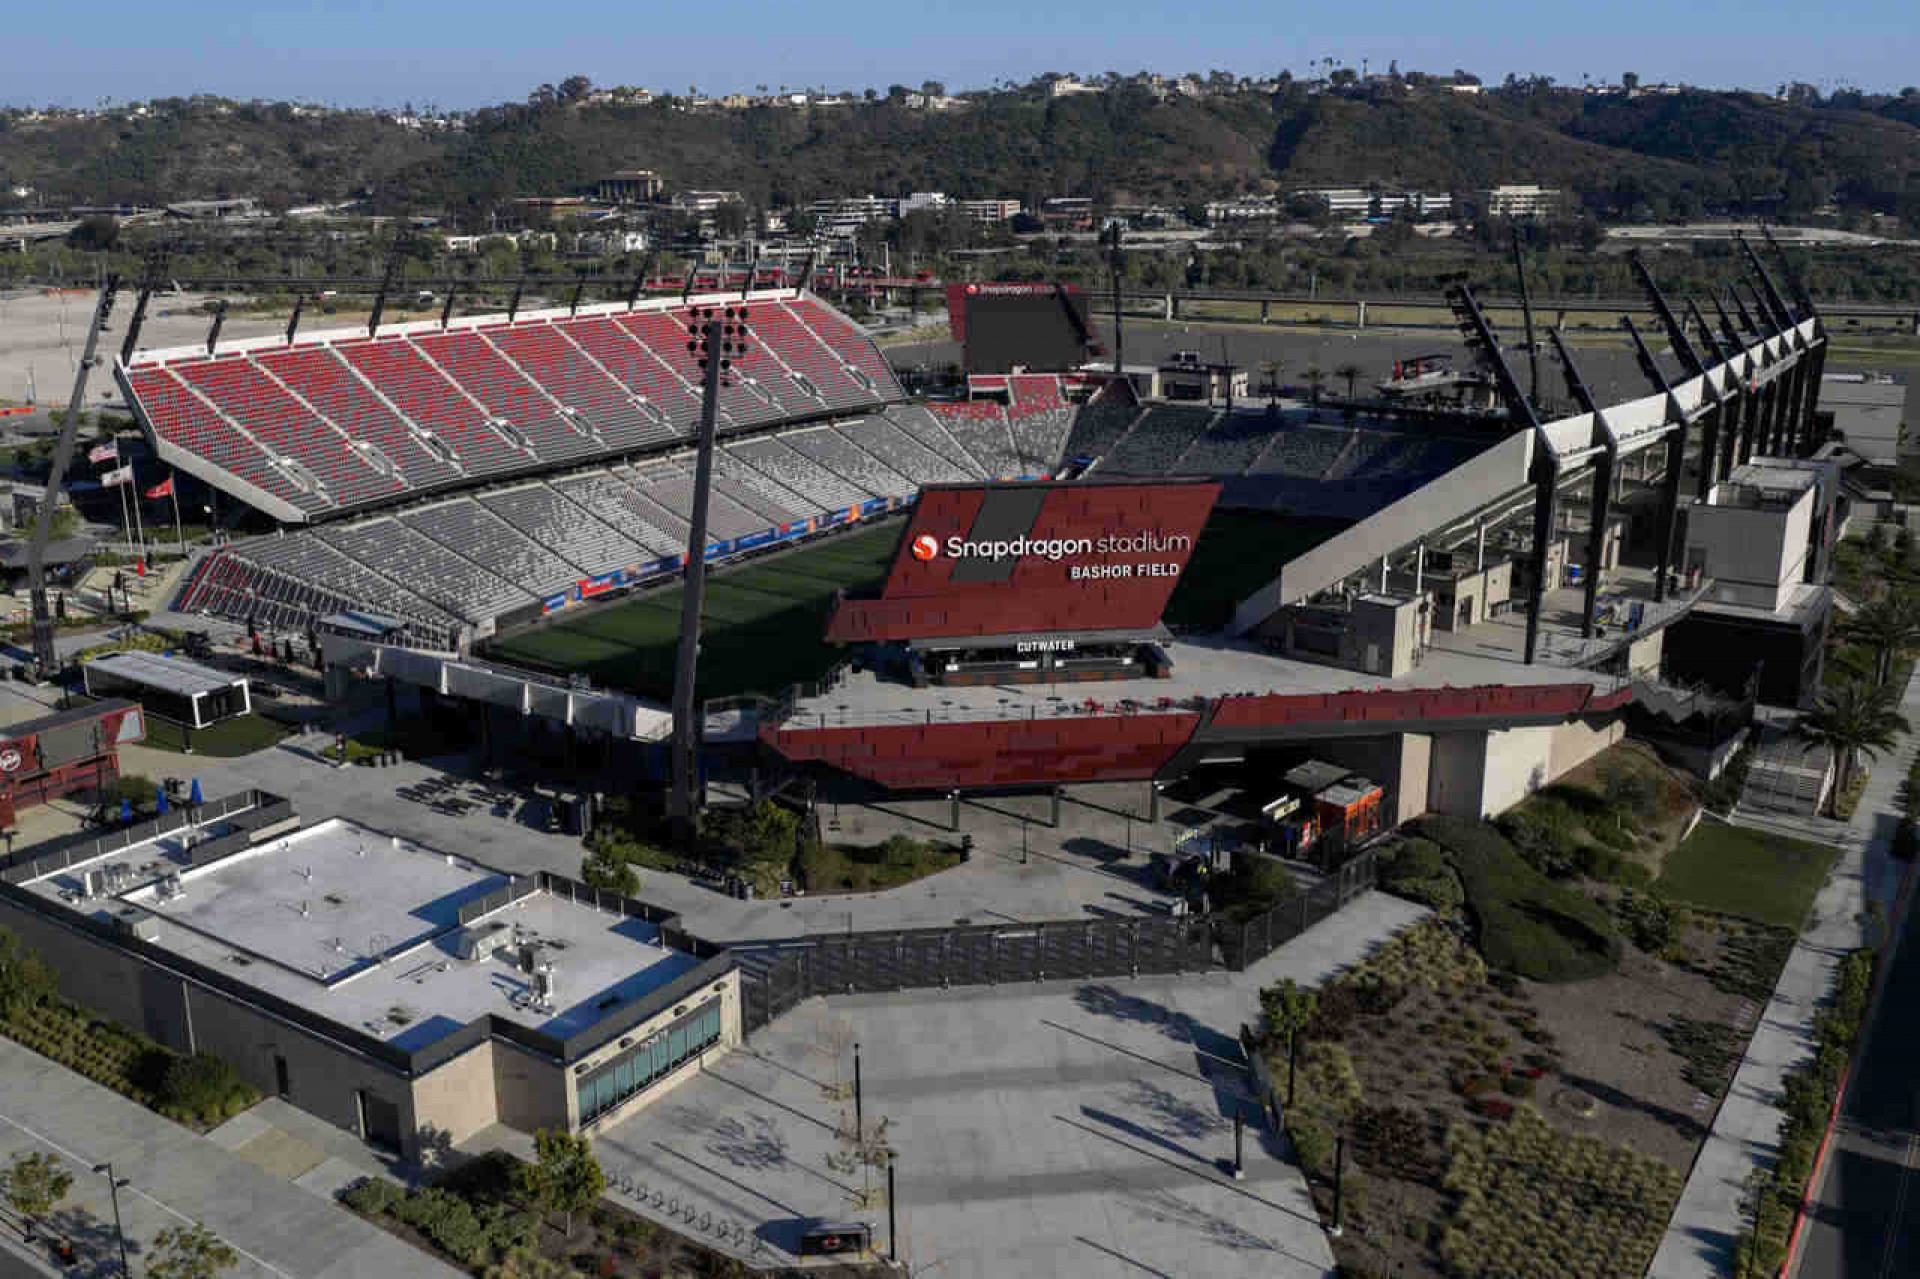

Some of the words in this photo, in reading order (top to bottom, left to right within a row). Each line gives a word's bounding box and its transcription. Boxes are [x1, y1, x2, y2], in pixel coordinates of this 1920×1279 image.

[947, 535, 1092, 561] Snapdragon
[1097, 530, 1191, 553] stadium
[1071, 565, 1132, 580] BASHOR
[1137, 563, 1180, 578] FIELD
